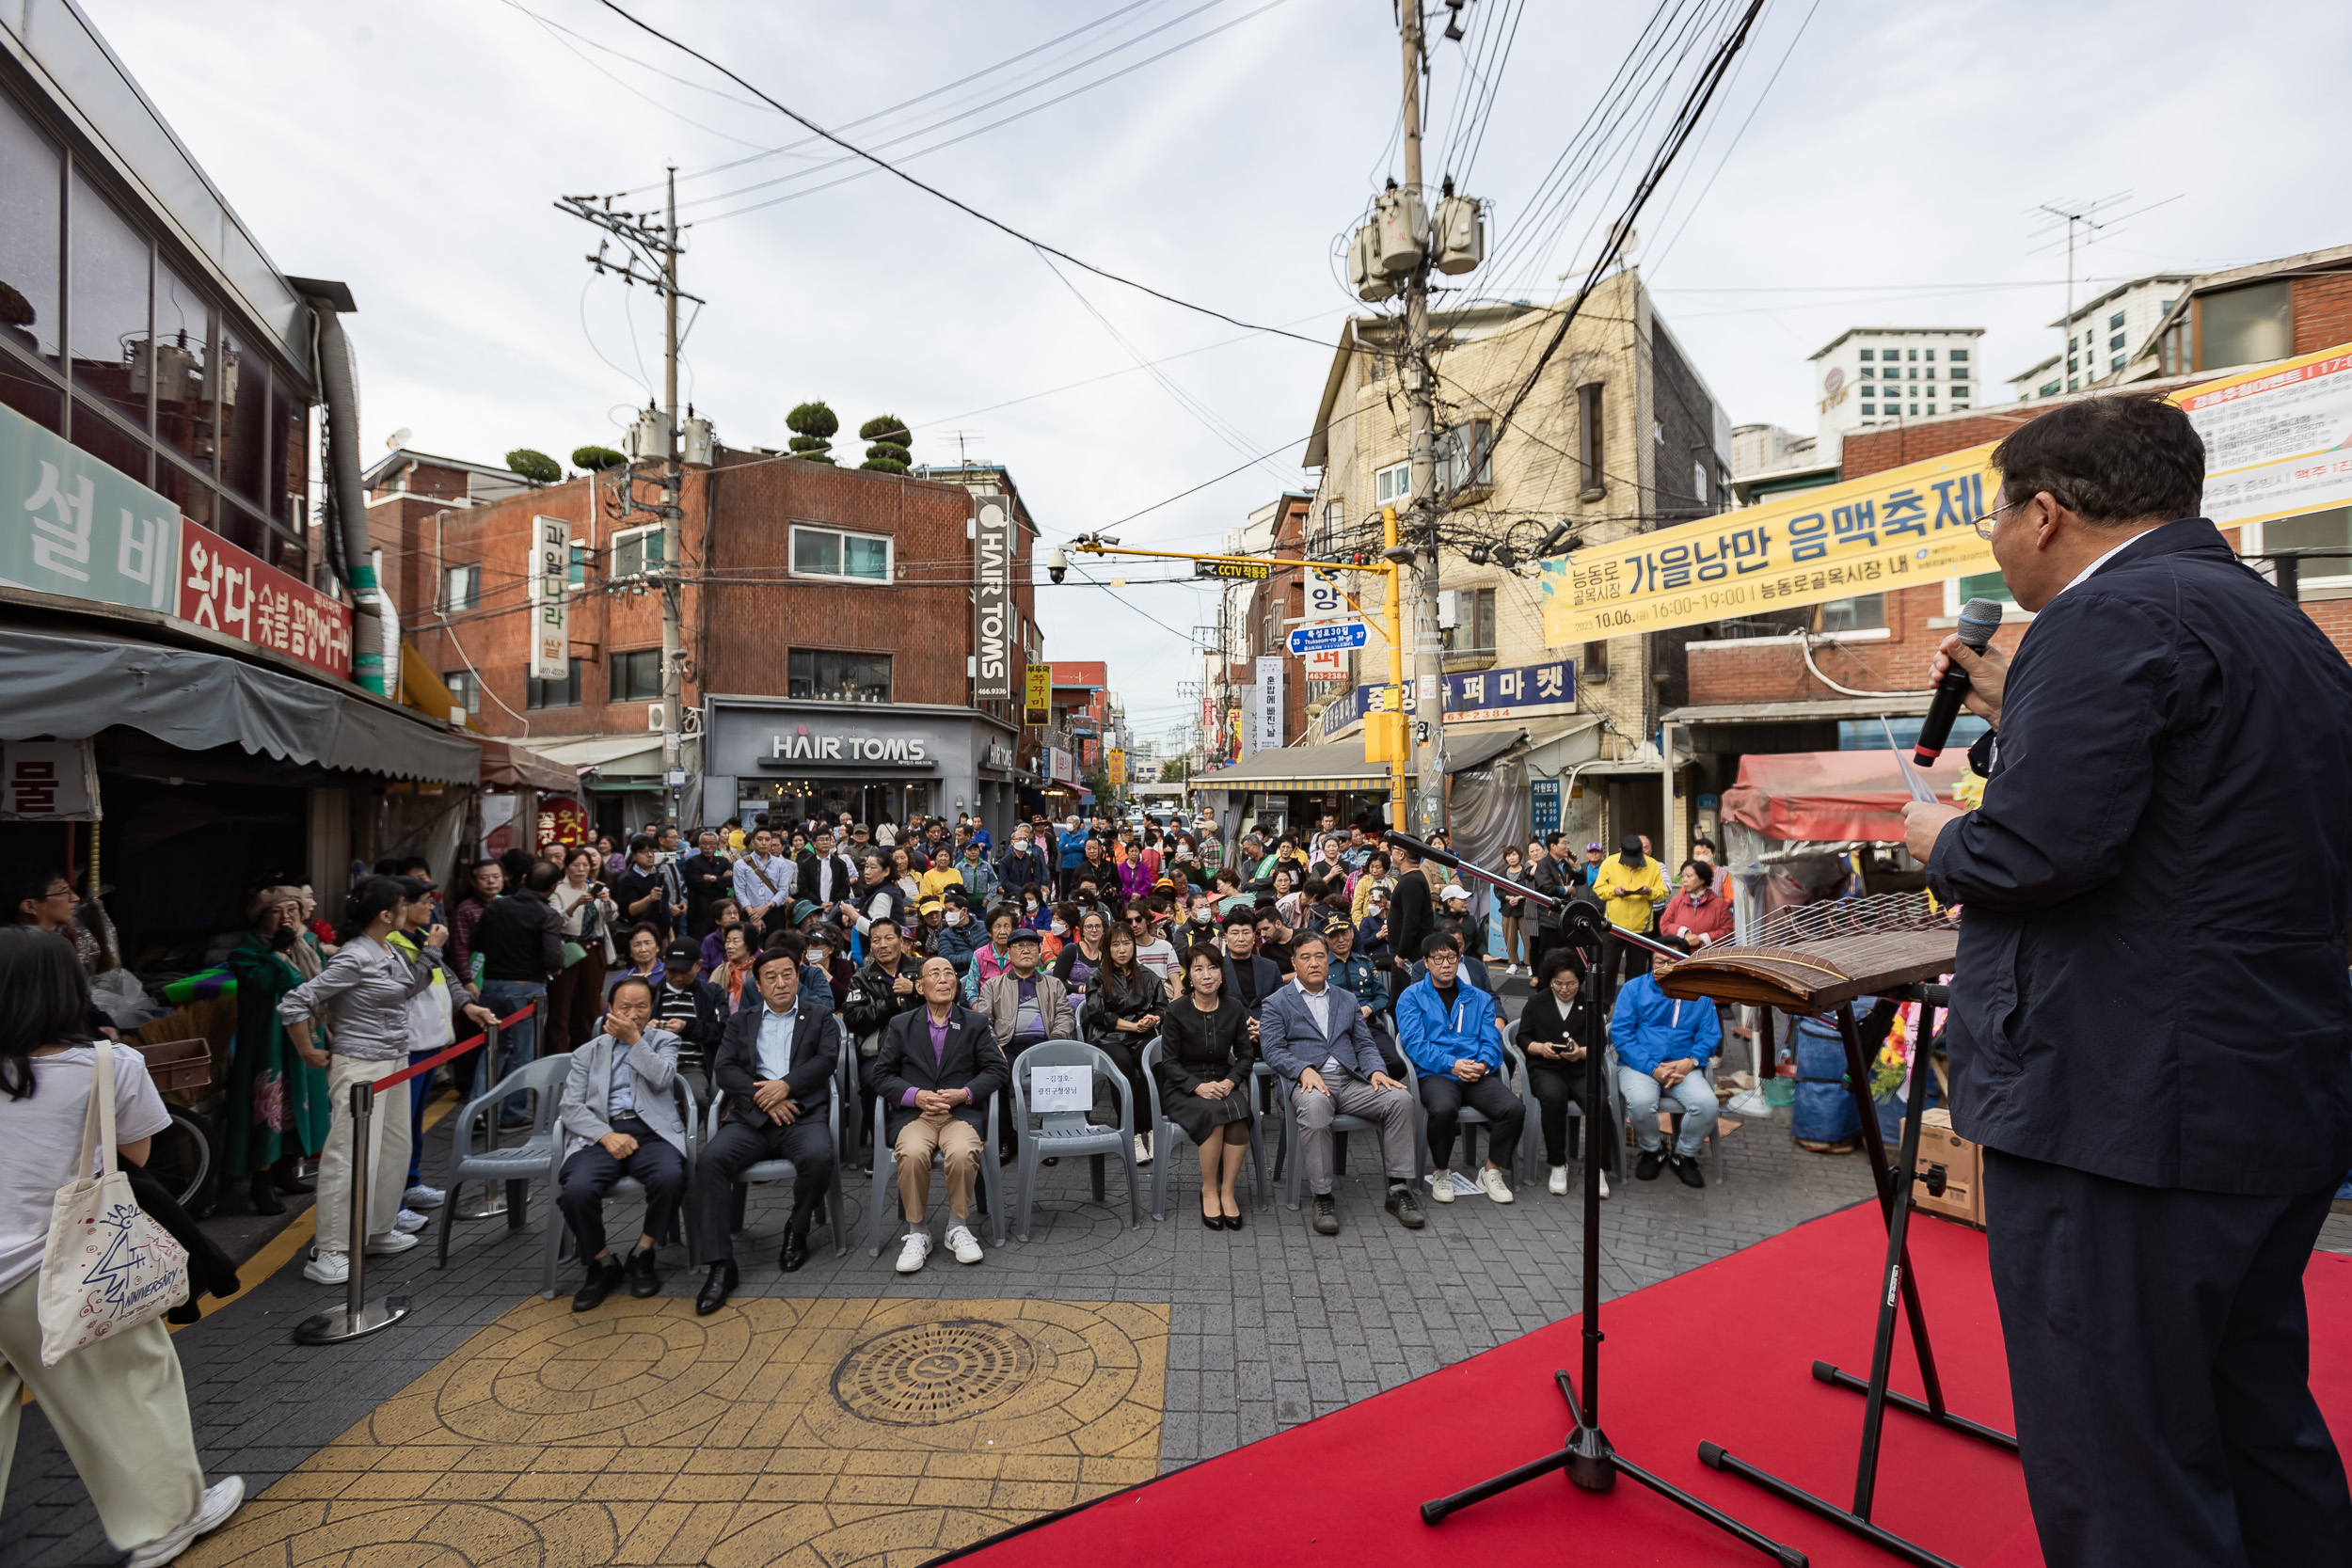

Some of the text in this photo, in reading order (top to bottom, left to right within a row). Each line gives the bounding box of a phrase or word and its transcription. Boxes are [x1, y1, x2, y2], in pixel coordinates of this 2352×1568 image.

[24, 460, 169, 609] 설비
[1624, 472, 1985, 594] 가을낭만 음맥축제
[545, 525, 564, 629] 과일나라
[1218, 565, 1268, 579] CCTV 작동중
[1572, 561, 1620, 589] 능동로
[1573, 583, 1621, 606] 골목시장
[1651, 585, 1746, 620] 16:00~19:00
[1761, 559, 1883, 600] 능동로골목시장
[1889, 555, 1910, 575] 내
[981, 532, 1004, 679] HAIR TOMS
[543, 639, 563, 658] 쌀
[1030, 674, 1045, 707] 쭈꾸미
[1440, 708, 1510, 722] 63-2384
[772, 736, 925, 760] HAIR TOMS
[1534, 783, 1558, 793] 사원모집
